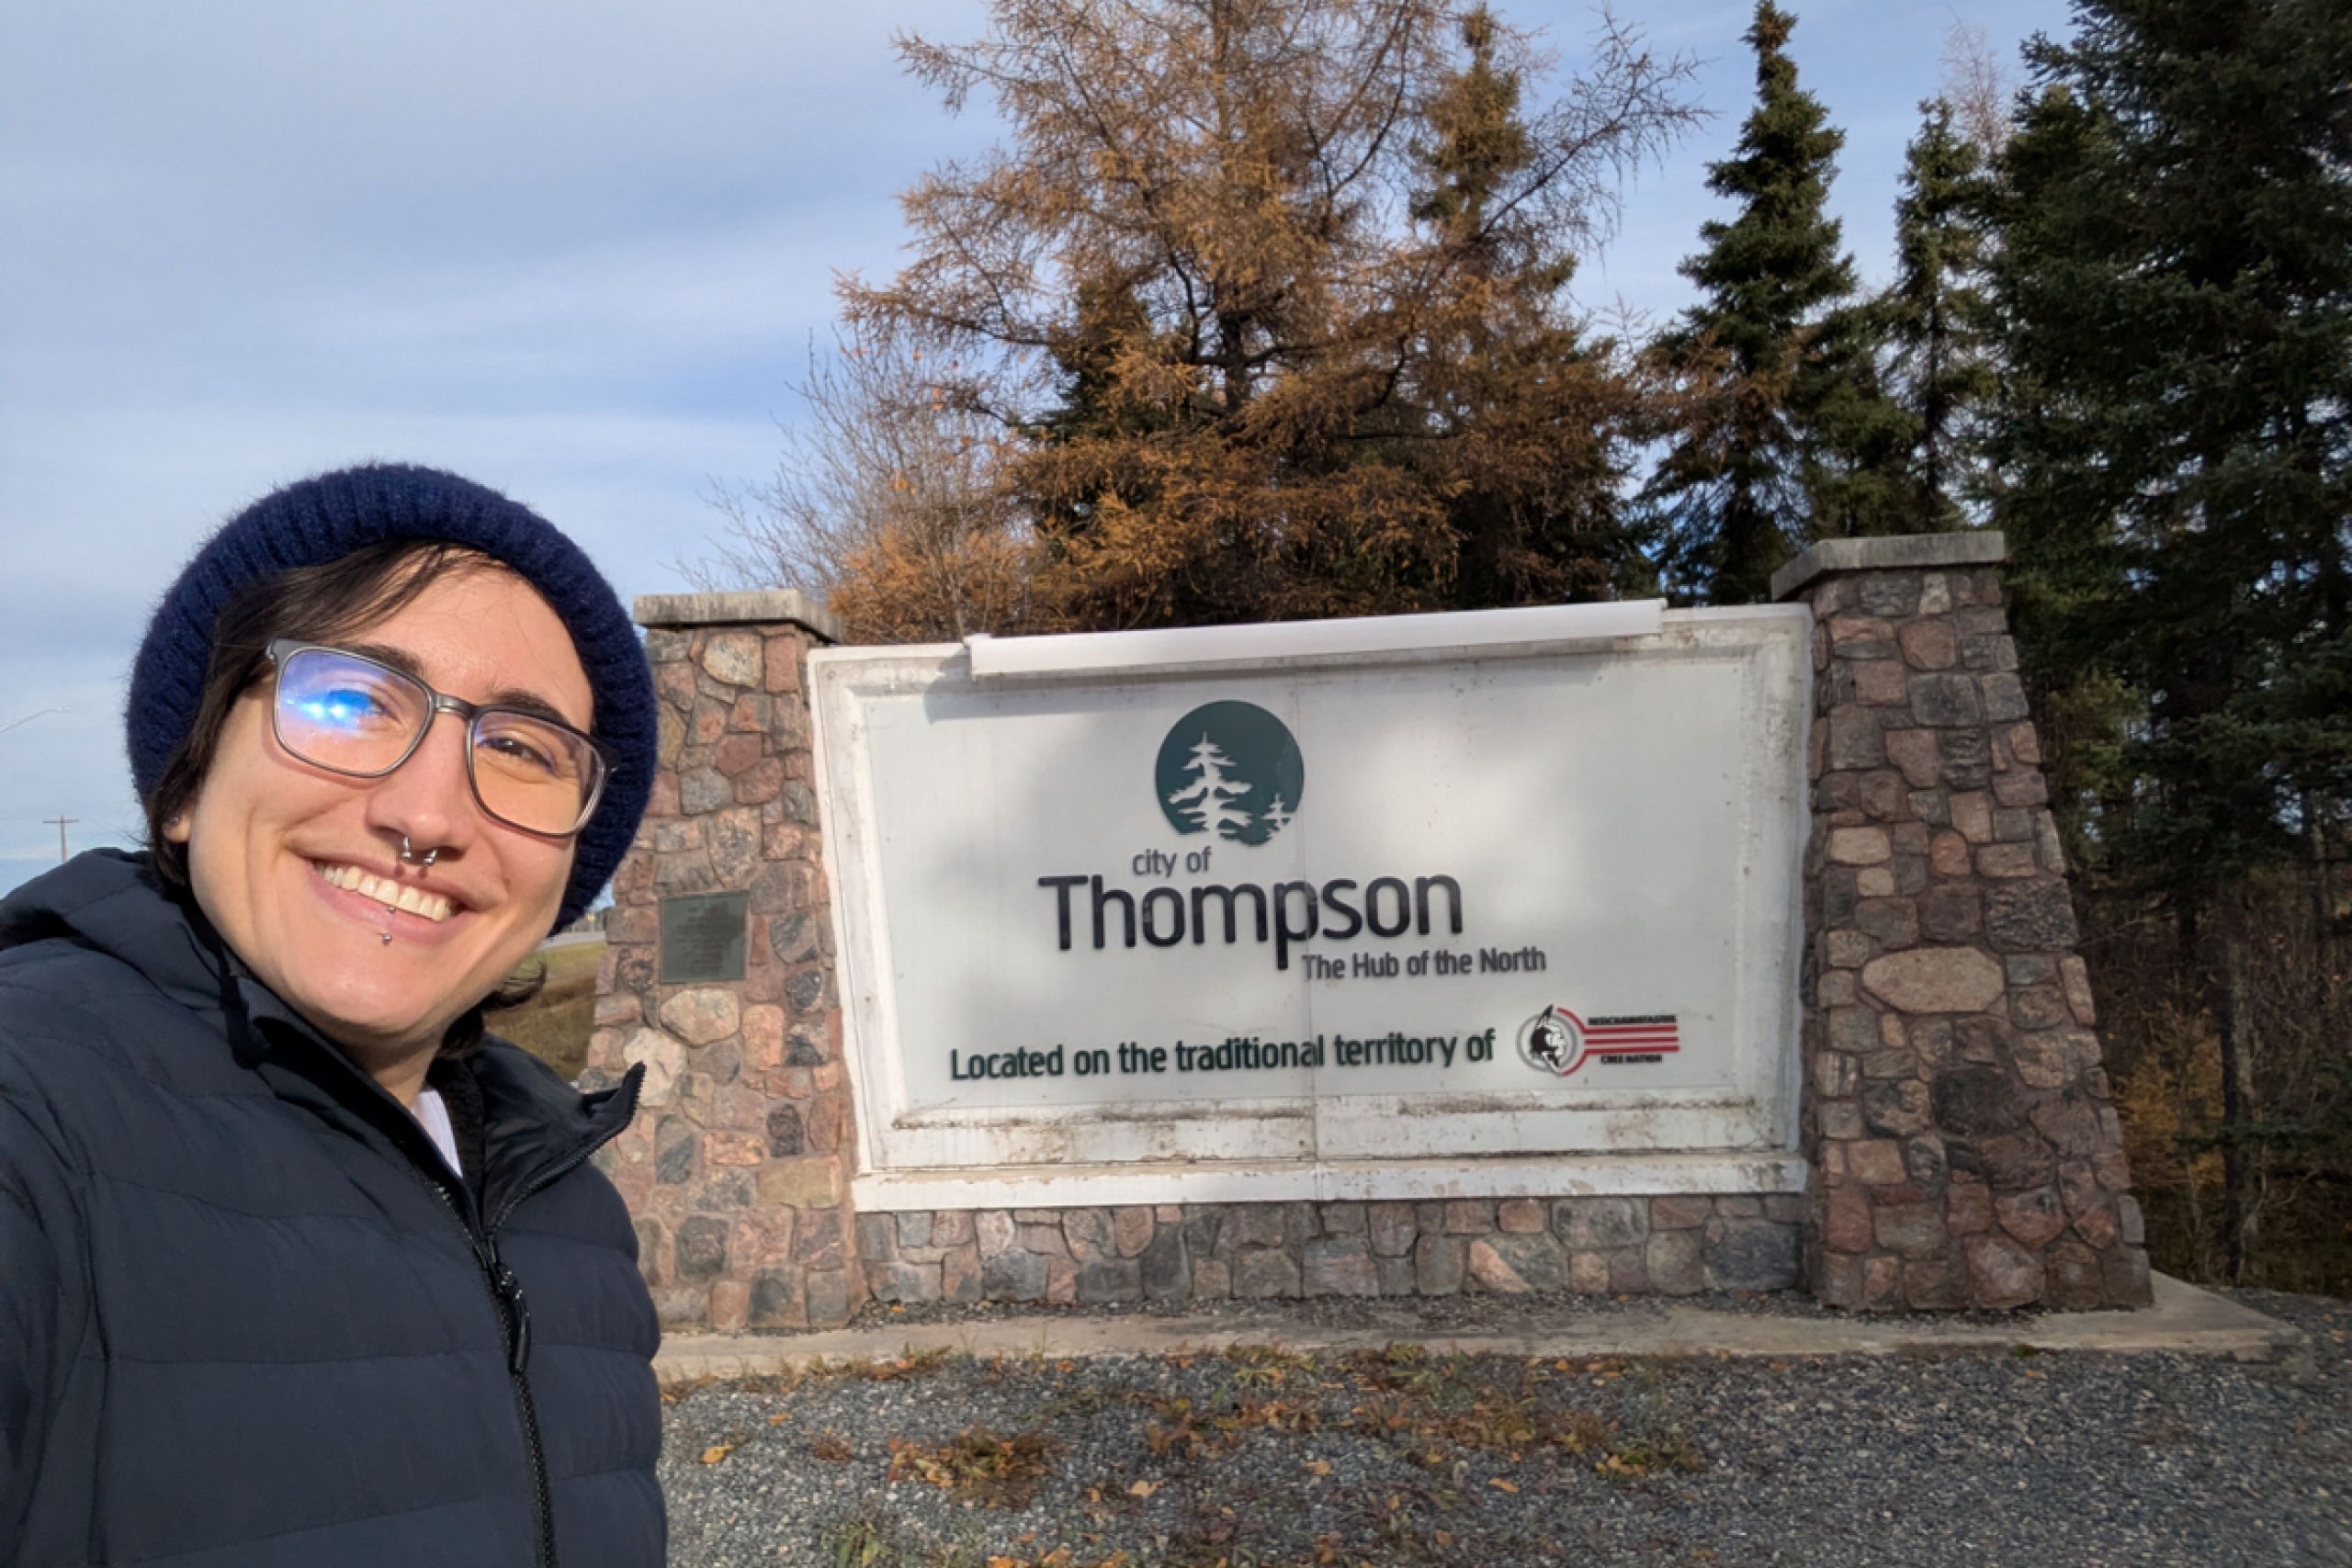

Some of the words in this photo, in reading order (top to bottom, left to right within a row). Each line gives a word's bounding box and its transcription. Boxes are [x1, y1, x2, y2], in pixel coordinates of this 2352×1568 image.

[1132, 849, 1178, 878] city
[1186, 844, 1212, 873] of
[1037, 874, 1464, 972] Thompson
[1302, 953, 1346, 981] The
[1351, 952, 1400, 979] Hub
[1407, 950, 1430, 976] of
[1433, 948, 1473, 976] the
[1478, 945, 1547, 974] North
[950, 1043, 1064, 1081] Located
[1073, 1049, 1110, 1076] on
[1117, 1040, 1167, 1073] the
[1174, 1034, 1326, 1072] traditional
[1333, 1031, 1458, 1068] territory
[1465, 1027, 1496, 1061] of
